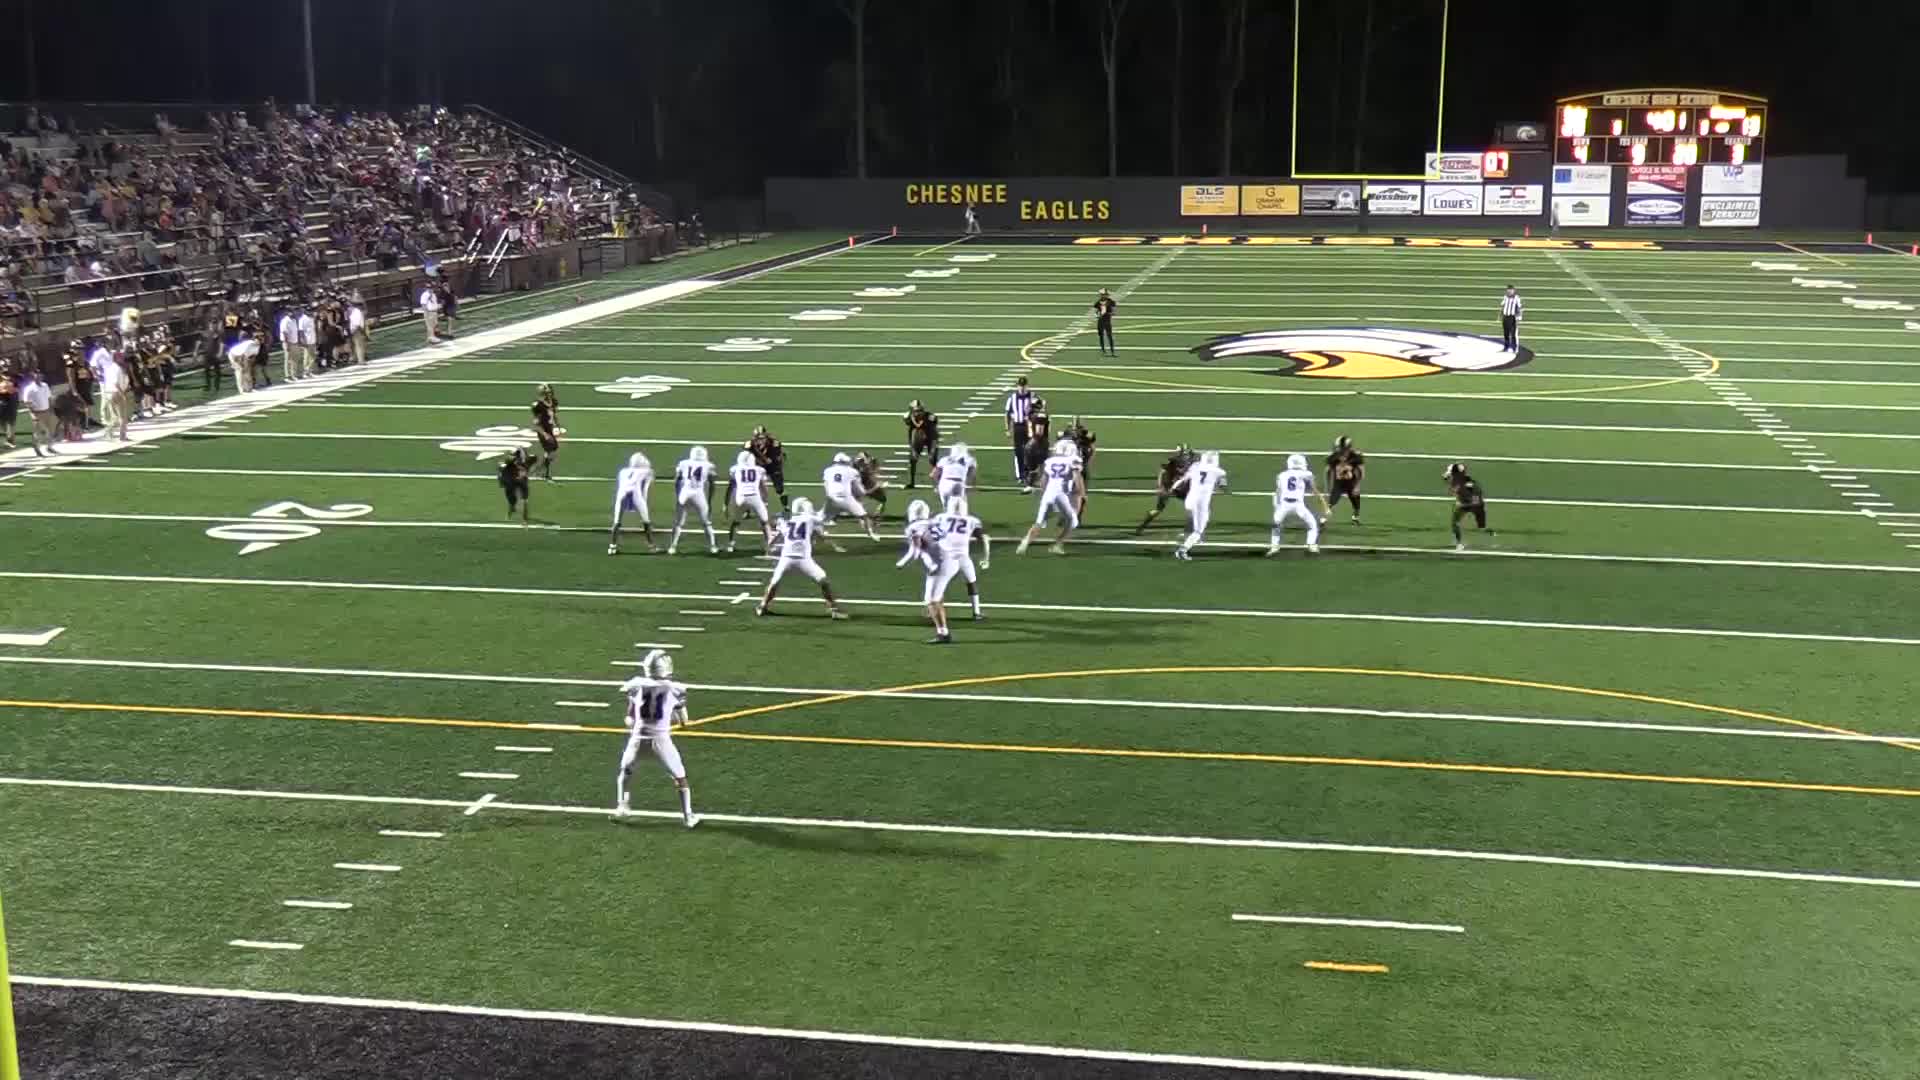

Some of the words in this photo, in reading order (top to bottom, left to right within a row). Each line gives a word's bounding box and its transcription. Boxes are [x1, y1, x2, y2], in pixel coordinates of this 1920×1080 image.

[906, 184, 1007, 204] CHESNEE
[1020, 200, 1110, 220] EAGLES
[1433, 199, 1473, 209] LOWE'S
[687, 466, 704, 482] 14
[741, 468, 757, 483] 10
[1287, 476, 1298, 491] 6
[947, 517, 968, 535] 72
